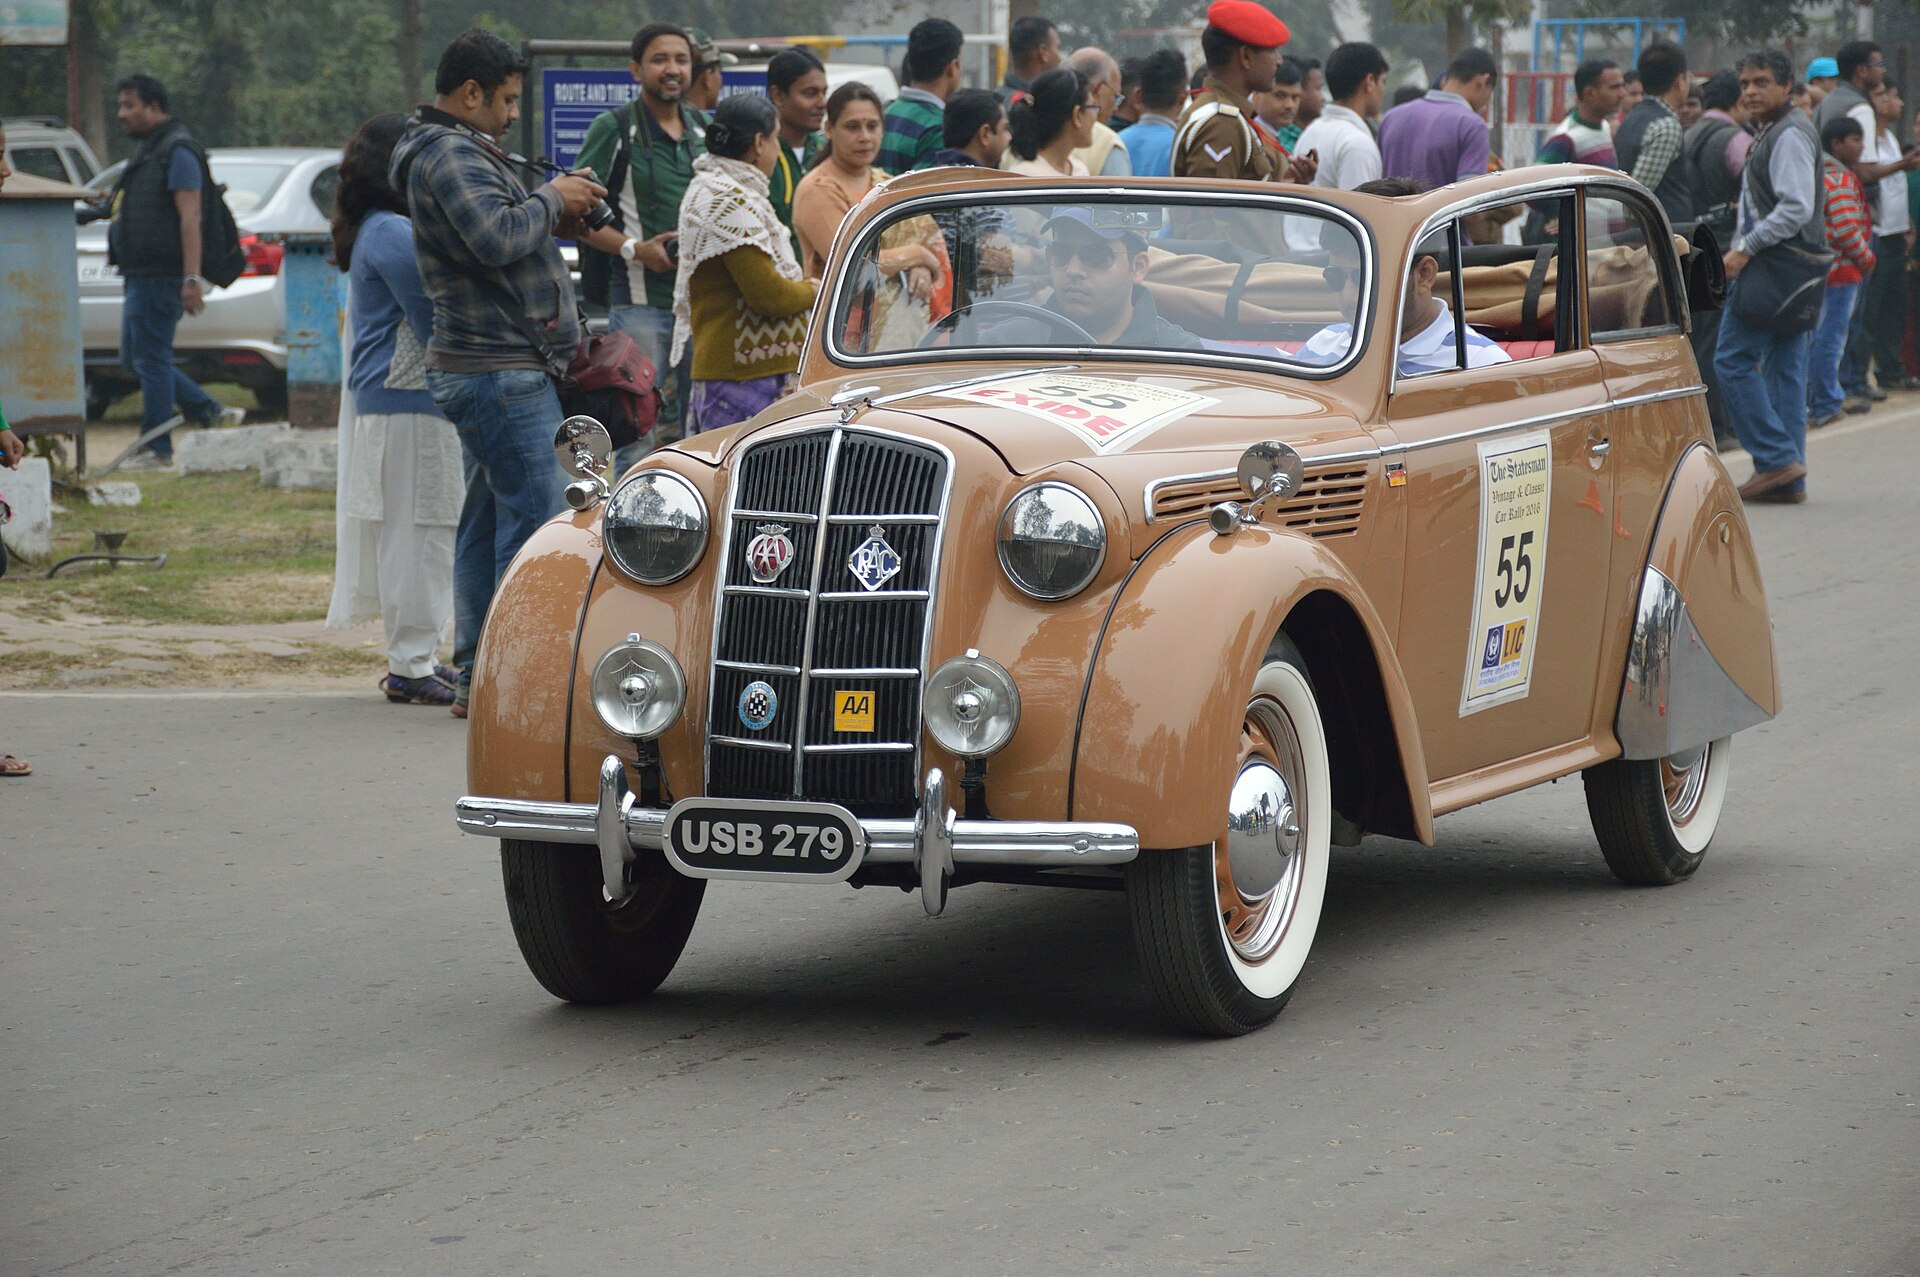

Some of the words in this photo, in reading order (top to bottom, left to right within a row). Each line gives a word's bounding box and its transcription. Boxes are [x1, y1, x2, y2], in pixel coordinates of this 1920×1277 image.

[554, 83, 586, 102] ROUTE
[587, 83, 607, 102] AND
[607, 83, 631, 103] TIME
[1028, 386, 1139, 409] 55
[967, 389, 1127, 436] EXIDE
[1490, 462, 1506, 483] The
[1507, 457, 1546, 479] Statesman
[1517, 485, 1523, 498] &
[1524, 482, 1545, 497] Classic
[1495, 511, 1507, 524] Car
[1509, 506, 1525, 520] Rally
[1526, 502, 1541, 517] 2016
[857, 542, 896, 580] RAC
[1494, 530, 1534, 609] 55
[1503, 625, 1526, 659] LIC
[841, 695, 869, 715] AA
[681, 819, 764, 856] USB
[771, 823, 844, 861] 279
